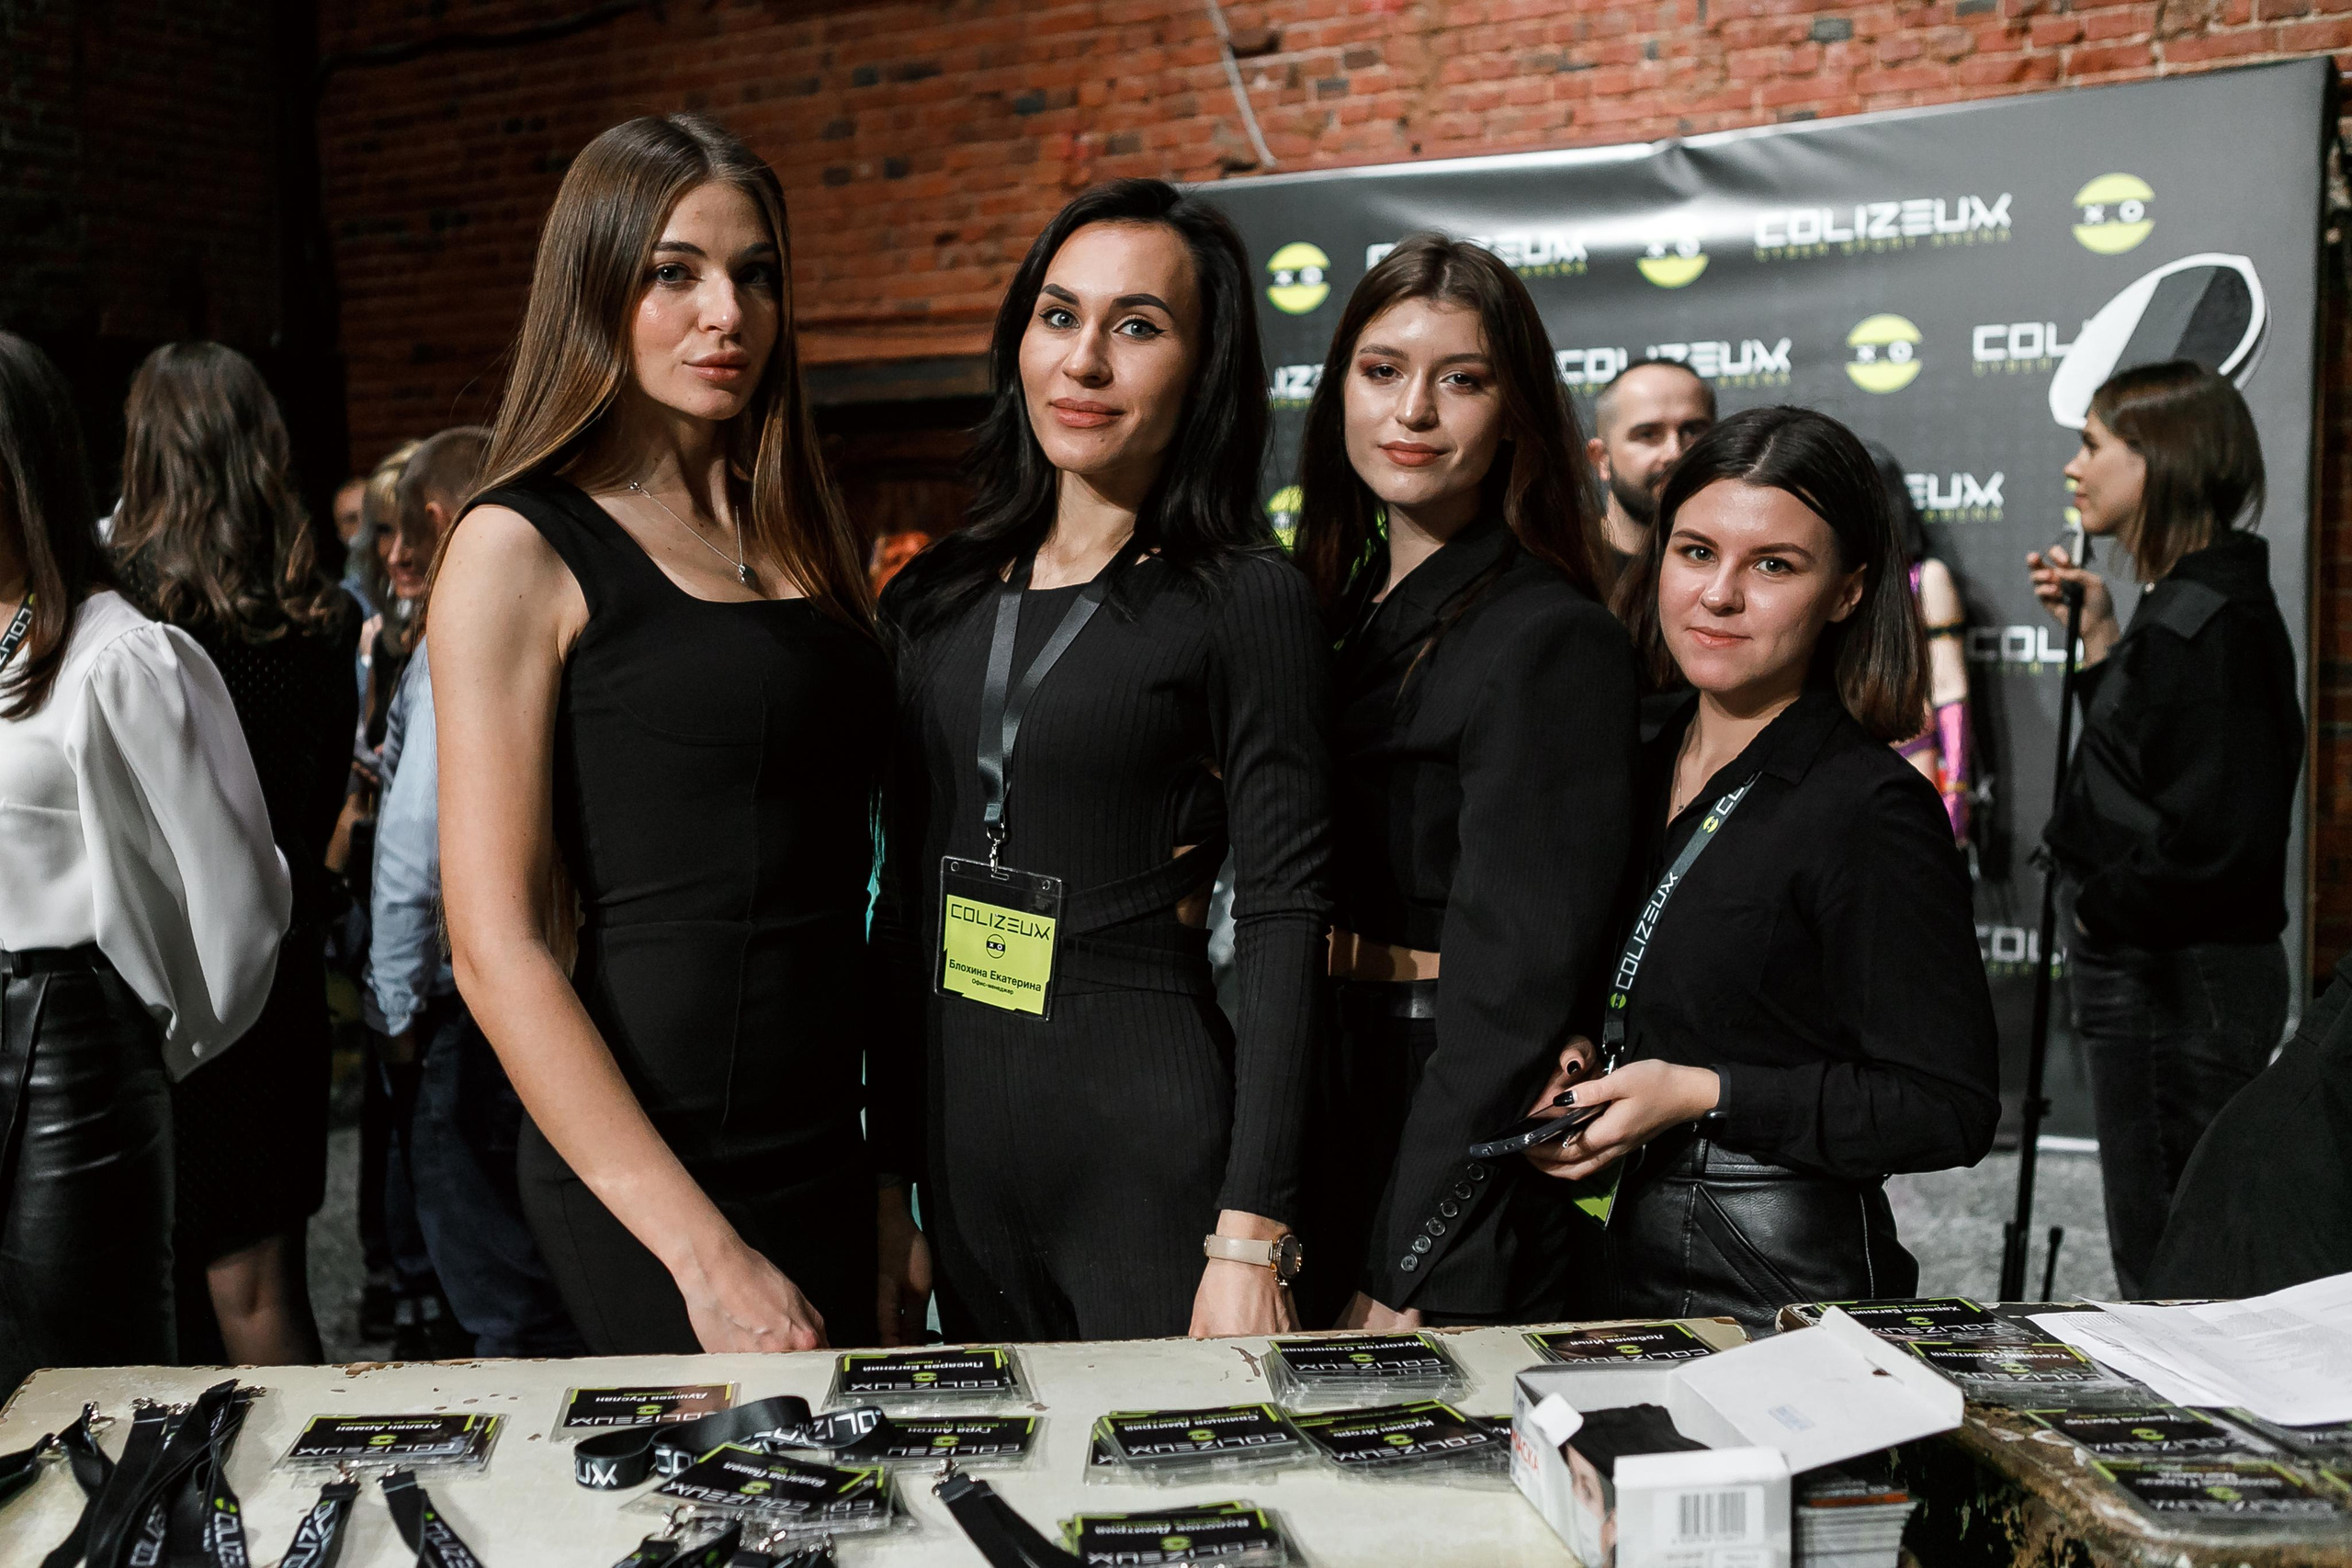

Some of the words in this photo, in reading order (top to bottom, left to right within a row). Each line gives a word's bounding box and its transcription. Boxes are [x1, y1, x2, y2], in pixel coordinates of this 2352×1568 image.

[1754, 192, 2012, 248] COLIZEUM
[950, 903, 1051, 941] COLIZEUM
[1615, 872, 1679, 991] COLIZEUM
[948, 958, 988, 979] Блохина
[989, 970, 1042, 993] Екатерина
[971, 977, 1014, 996] Офис-менеджер
[1357, 1340, 1425, 1350] Мухортов
[1606, 1334, 1664, 1343] Лобанов
[924, 1360, 983, 1370] Писарев
[1295, 1358, 1441, 1371] COLIZEUM
[852, 1380, 998, 1390] COLIZEUM
[297, 1443, 455, 1456] COLIZEUM
[888, 1443, 1020, 1456] COLIZEU
[1128, 1432, 1287, 1455] COLIZEUM
[1339, 1433, 1487, 1461] COLIZEUM
[662, 1482, 810, 1512] COLIZEUM
